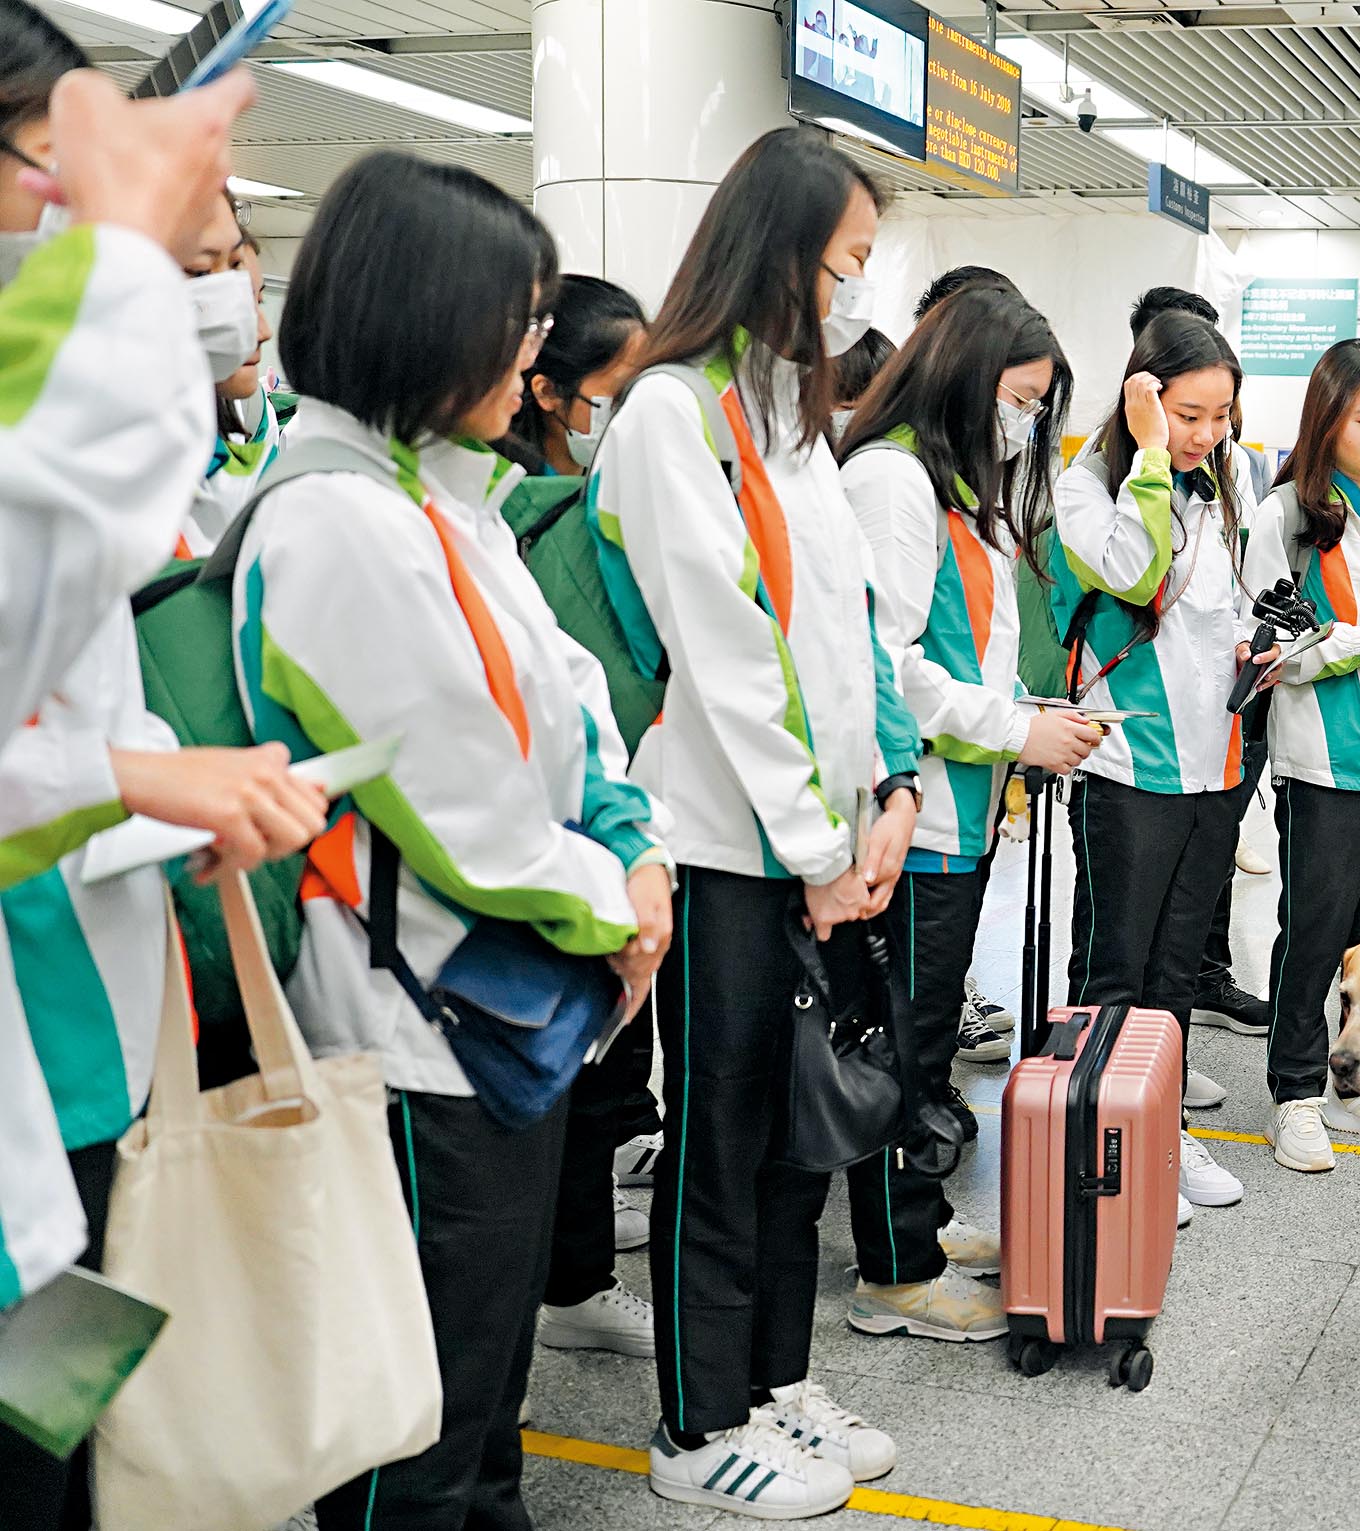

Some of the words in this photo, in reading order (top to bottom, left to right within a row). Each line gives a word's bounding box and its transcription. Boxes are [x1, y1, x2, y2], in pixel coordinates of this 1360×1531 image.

[928, 61, 949, 81] ctive
[950, 69, 968, 92] from
[970, 79, 978, 96] 16
[980, 84, 995, 109] July
[996, 93, 1012, 114] 2018
[928, 123, 968, 149] negotiable
[970, 139, 1009, 168] instruments
[1010, 158, 1018, 173] of
[934, 108, 943, 121] or
[946, 110, 977, 138] disclose
[978, 129, 1008, 153] currency
[1009, 143, 1017, 156] or
[940, 144, 956, 163] than
[958, 150, 970, 168] HKD
[1165, 195, 1184, 215] Customs
[1184, 205, 1206, 226] Inspection
